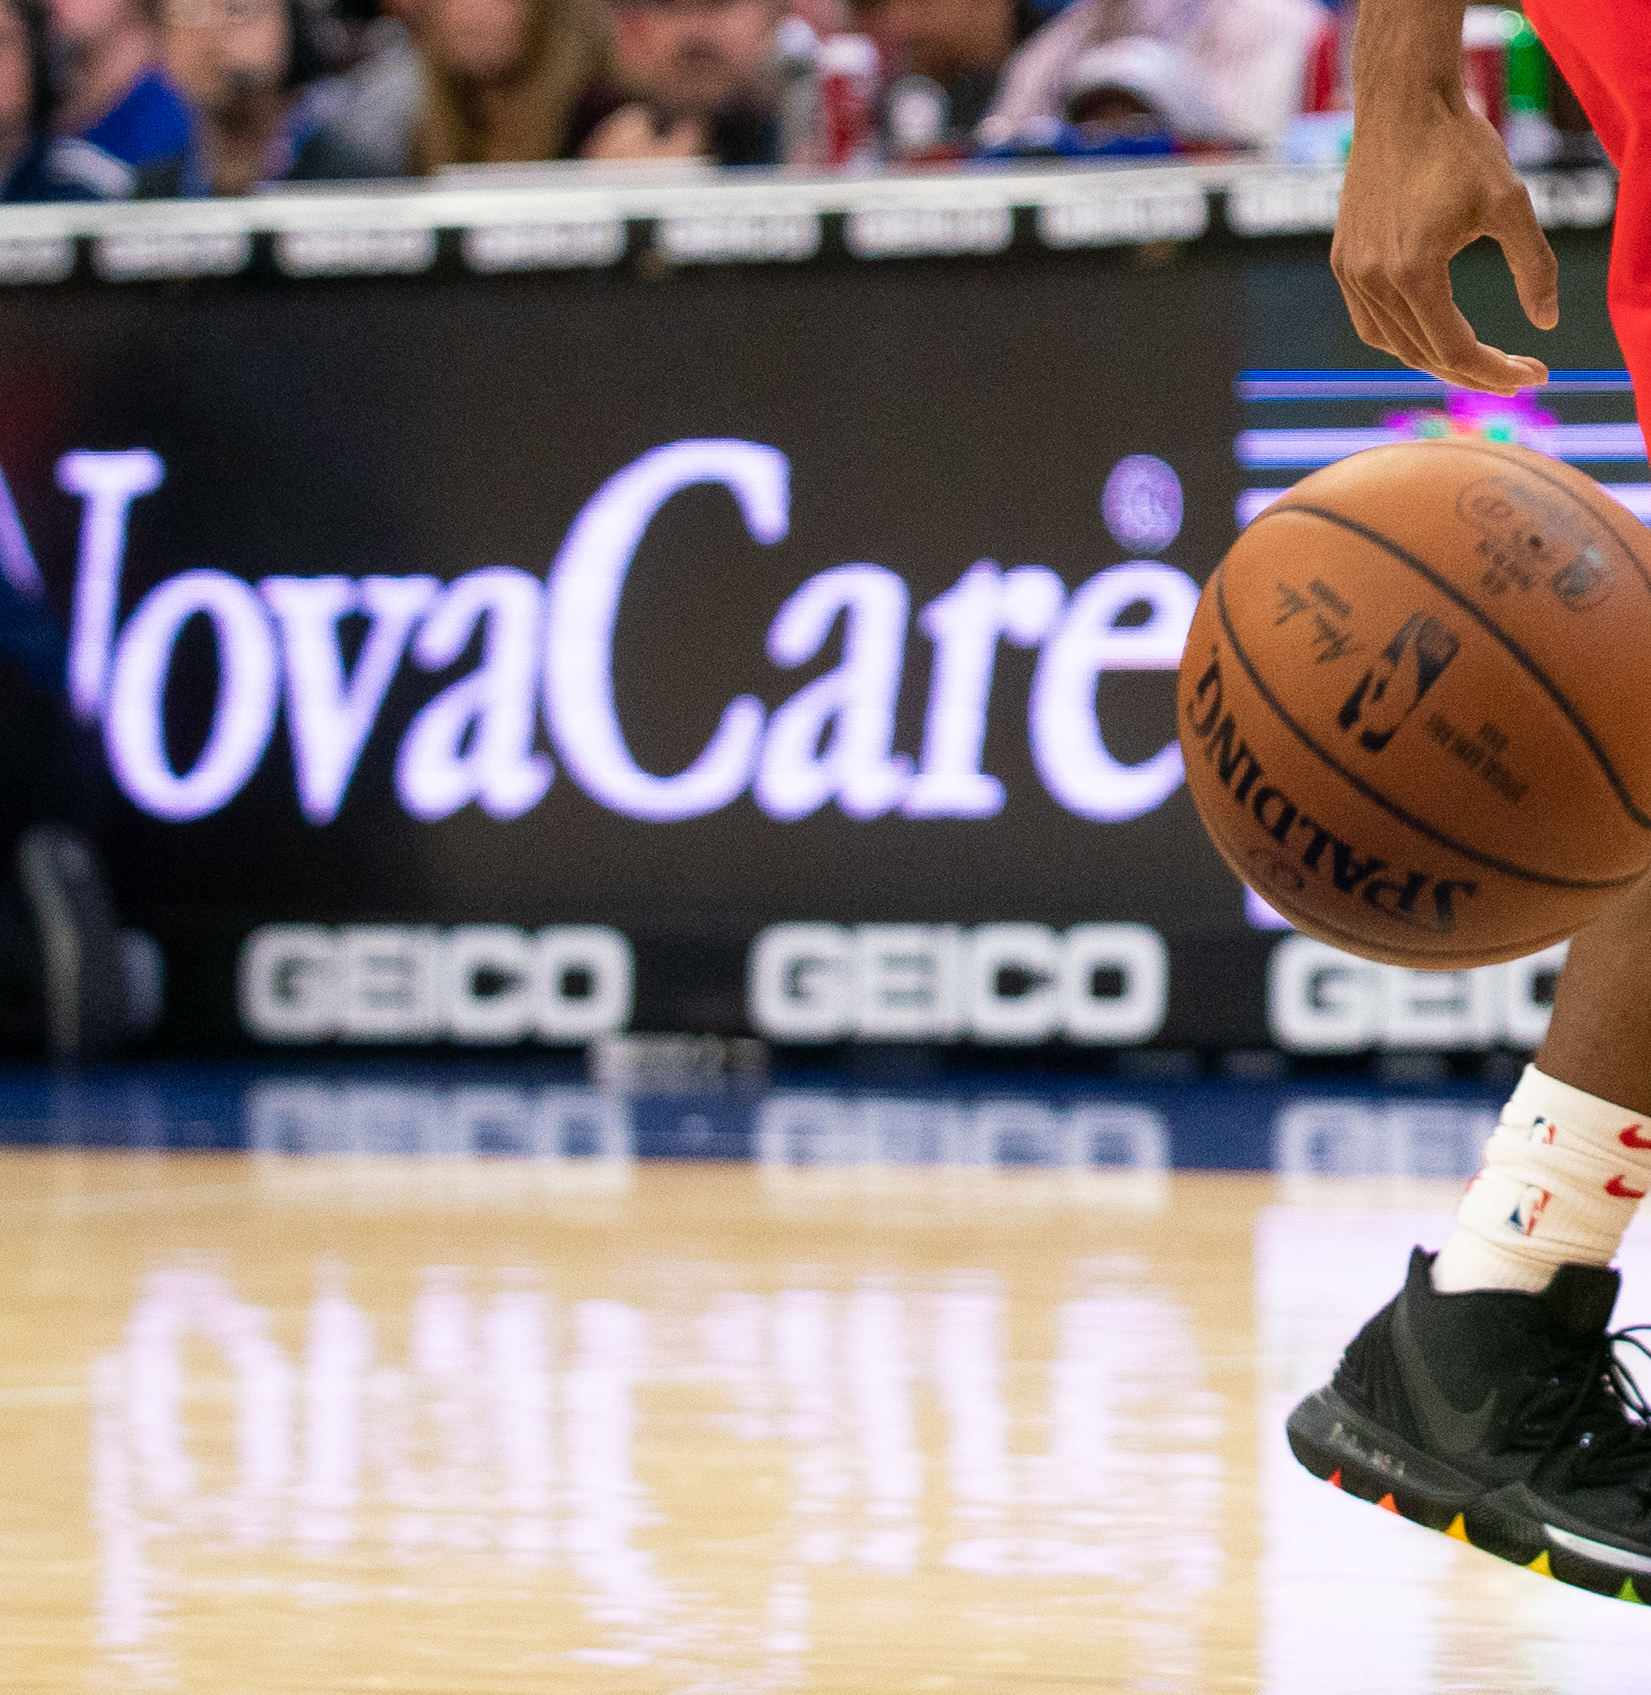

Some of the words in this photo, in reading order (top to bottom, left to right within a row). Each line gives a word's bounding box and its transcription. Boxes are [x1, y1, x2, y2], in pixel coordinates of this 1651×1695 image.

[1186, 654, 1477, 934] SPALDING
[238, 922, 634, 1044] GEICO
[748, 921, 1168, 1044] GEICO
[1268, 932, 1568, 1052] GEIC
